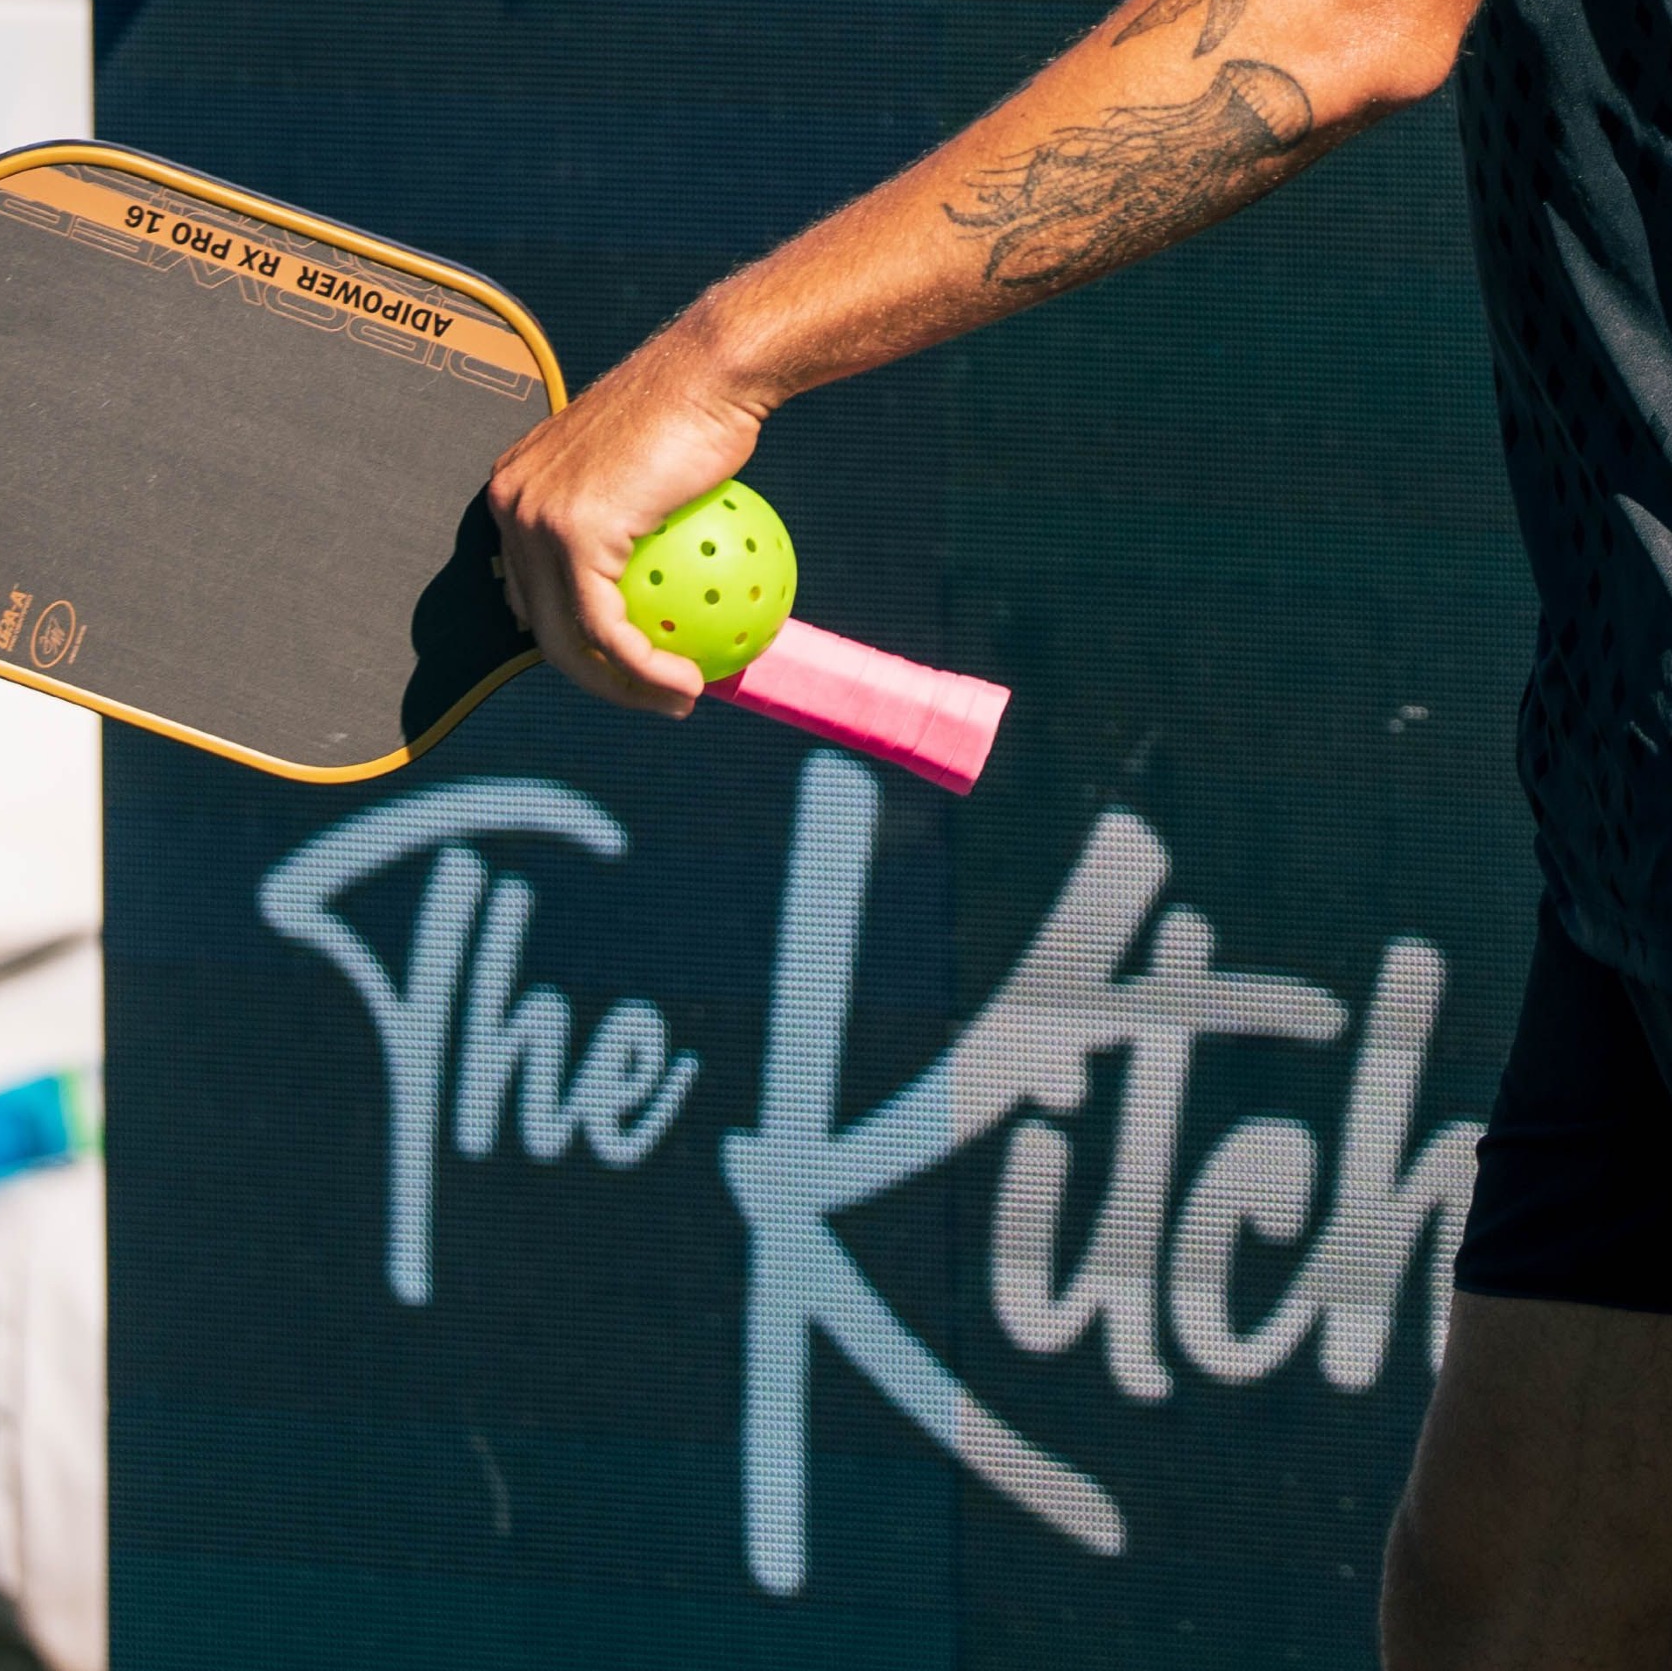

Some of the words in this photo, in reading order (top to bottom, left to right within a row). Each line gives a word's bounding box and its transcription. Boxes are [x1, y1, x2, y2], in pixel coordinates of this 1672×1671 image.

[124, 204, 166, 235] 16
[171, 220, 230, 261] PRO
[237, 243, 282, 279] RX
[296, 264, 454, 339] ADIPOWER
[257, 777, 699, 1306] The
